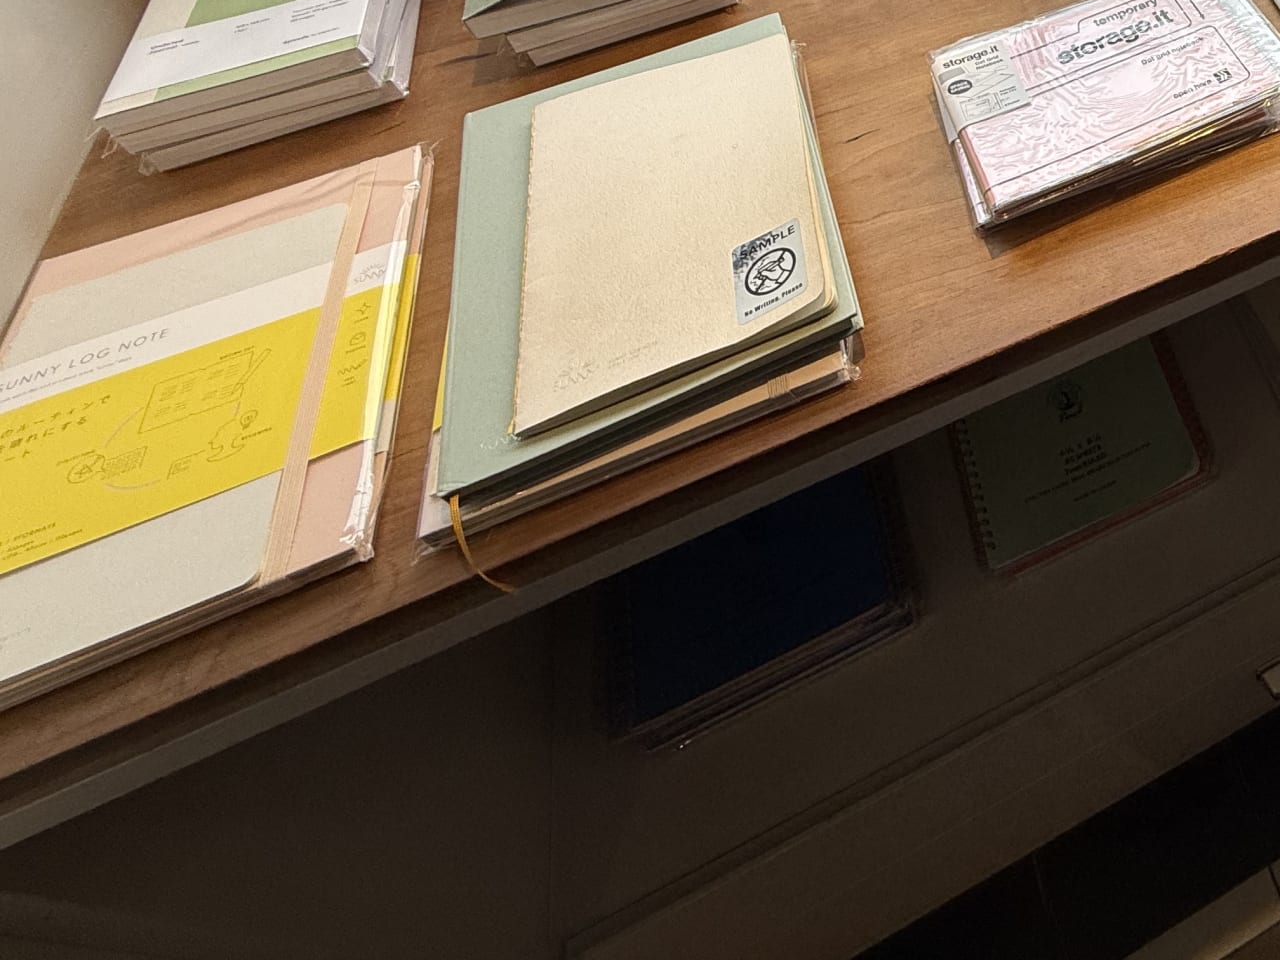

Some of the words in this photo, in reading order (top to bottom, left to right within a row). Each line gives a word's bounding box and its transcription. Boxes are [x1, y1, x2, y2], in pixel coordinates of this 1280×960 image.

[1057, 9, 1174, 65] storage.it
[942, 44, 1000, 70] storage.it
[740, 224, 796, 260] SAMPLE
[781, 282, 803, 298] Please
[68, 347, 111, 369] LOG
[118, 328, 169, 353] NOTE
